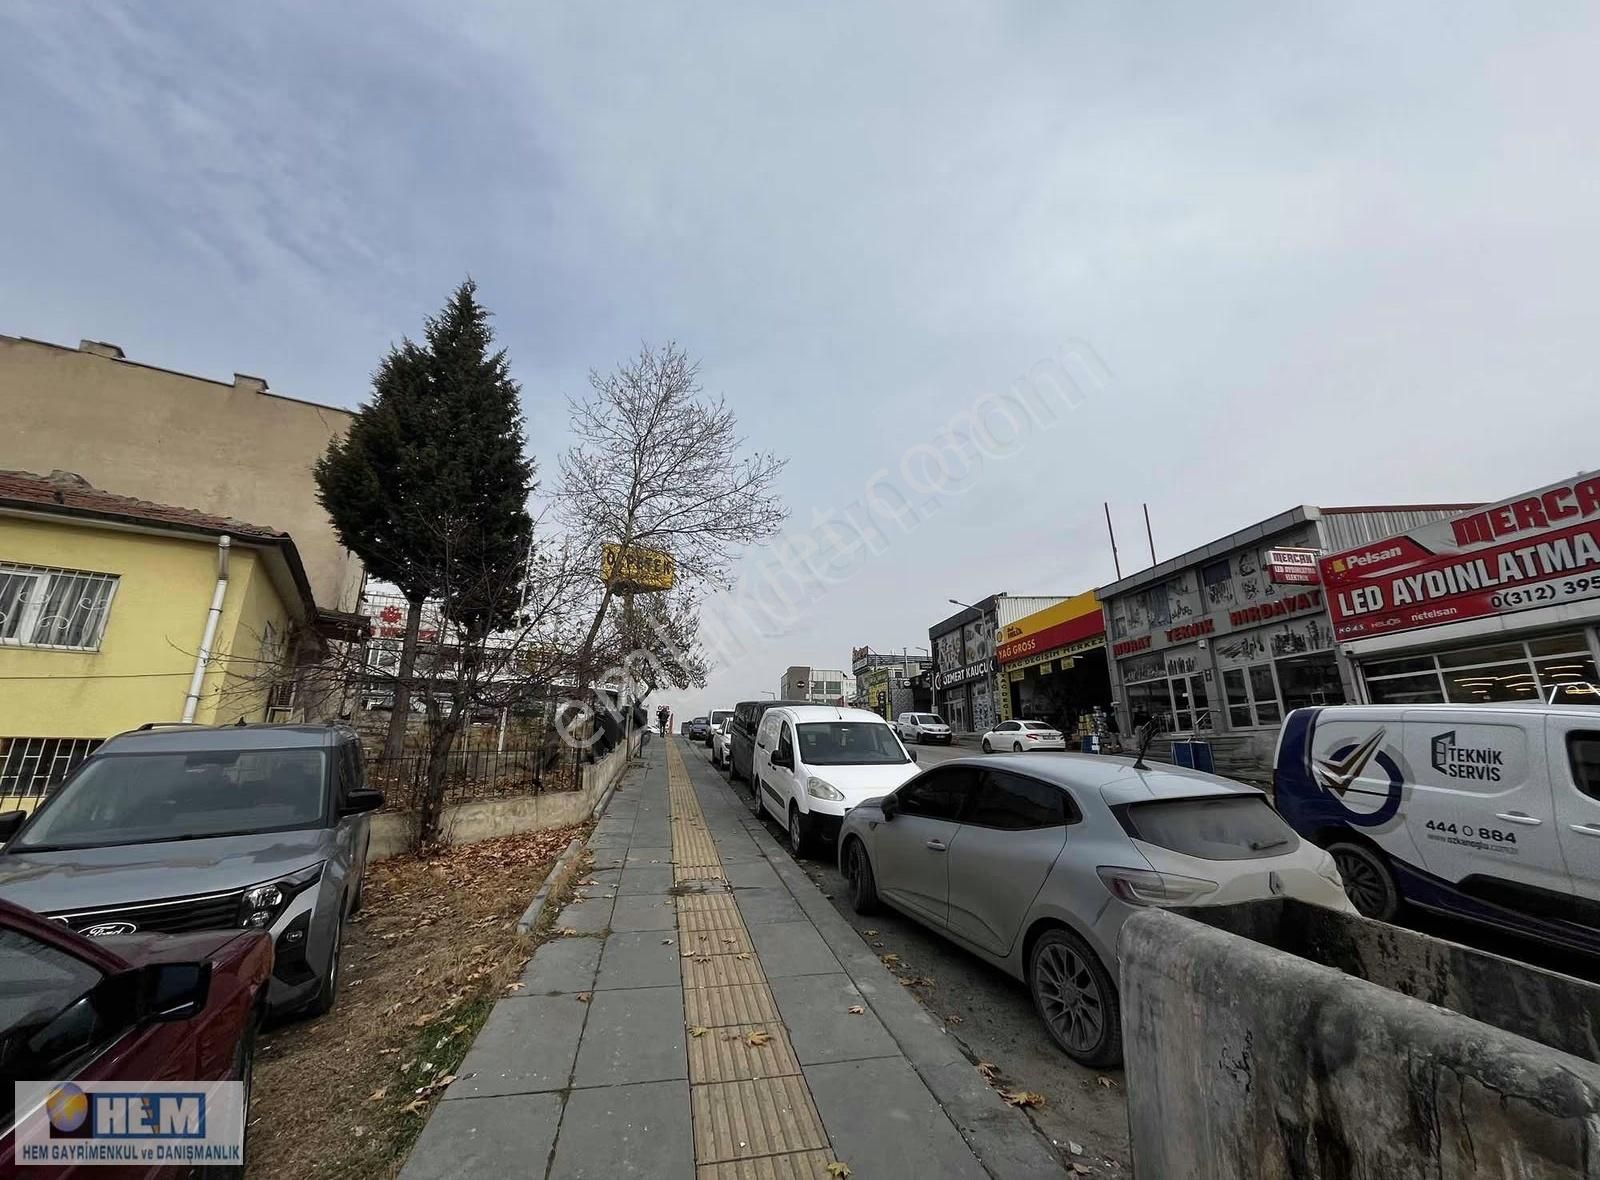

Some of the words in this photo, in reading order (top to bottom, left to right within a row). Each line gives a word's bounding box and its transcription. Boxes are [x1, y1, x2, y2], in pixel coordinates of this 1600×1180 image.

[1272, 552, 1312, 564] MERCAN
[1346, 547, 1402, 569] Pelsan
[1337, 585, 1384, 617] LED
[1393, 531, 1600, 606] AYDINLATMA
[1491, 584, 1556, 608] 0(312)
[1563, 576, 1600, 596] 395
[1113, 635, 1152, 656] MURAT
[1230, 590, 1321, 626] HIRDAVAT
[1411, 607, 1458, 621] netelsan
[998, 645, 1011, 658] YAĞ
[1013, 639, 1036, 656] GROSS
[1448, 747, 1503, 765] TEKNİK
[1448, 763, 1501, 782] SERVİS
[1426, 820, 1457, 834] 444
[1478, 828, 1516, 844] 884
